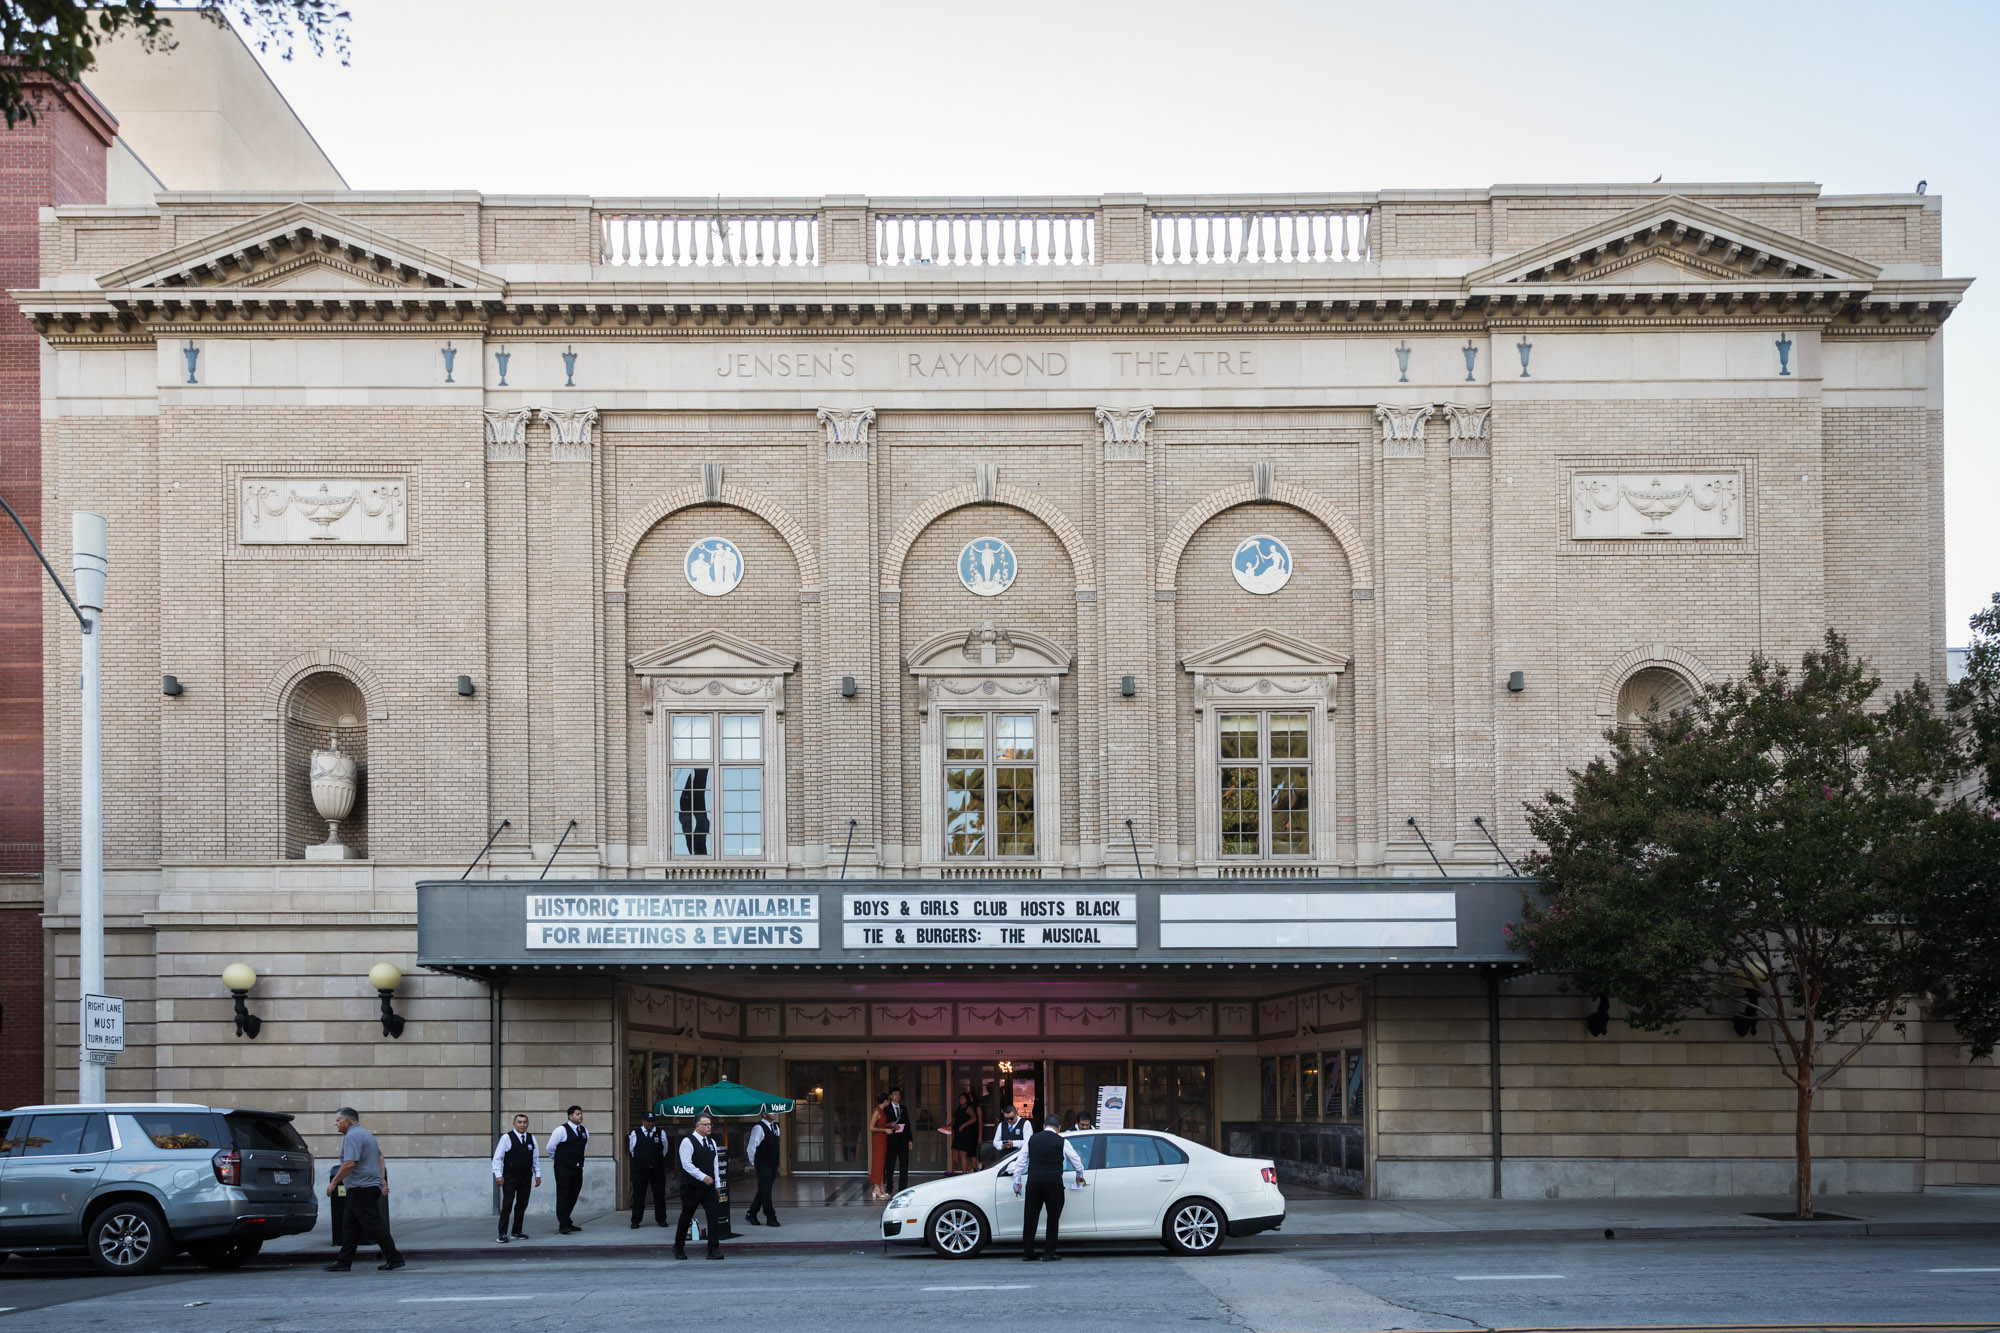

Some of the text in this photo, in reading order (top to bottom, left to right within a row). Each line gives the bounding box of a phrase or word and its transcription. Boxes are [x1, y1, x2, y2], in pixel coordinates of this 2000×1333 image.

[717, 346, 1256, 378] JENSEN'S RAYMOND THEATRE
[534, 897, 812, 917] HISTORIC THEATER AVAILABLE
[853, 900, 1121, 917] BOYS & GIRLS CLUB HOSTS BLACK
[542, 925, 804, 945] FOR MEETINGS & EVENTS
[862, 927, 1101, 944] TIE & BURGERS: THE MUSICAL
[88, 1002, 122, 1013] RIGHT LANE
[94, 1017, 115, 1029] MUST
[88, 1034, 122, 1045] TURN RIGHT
[672, 1106, 695, 1114] Valet
[771, 1103, 787, 1111] Valet
